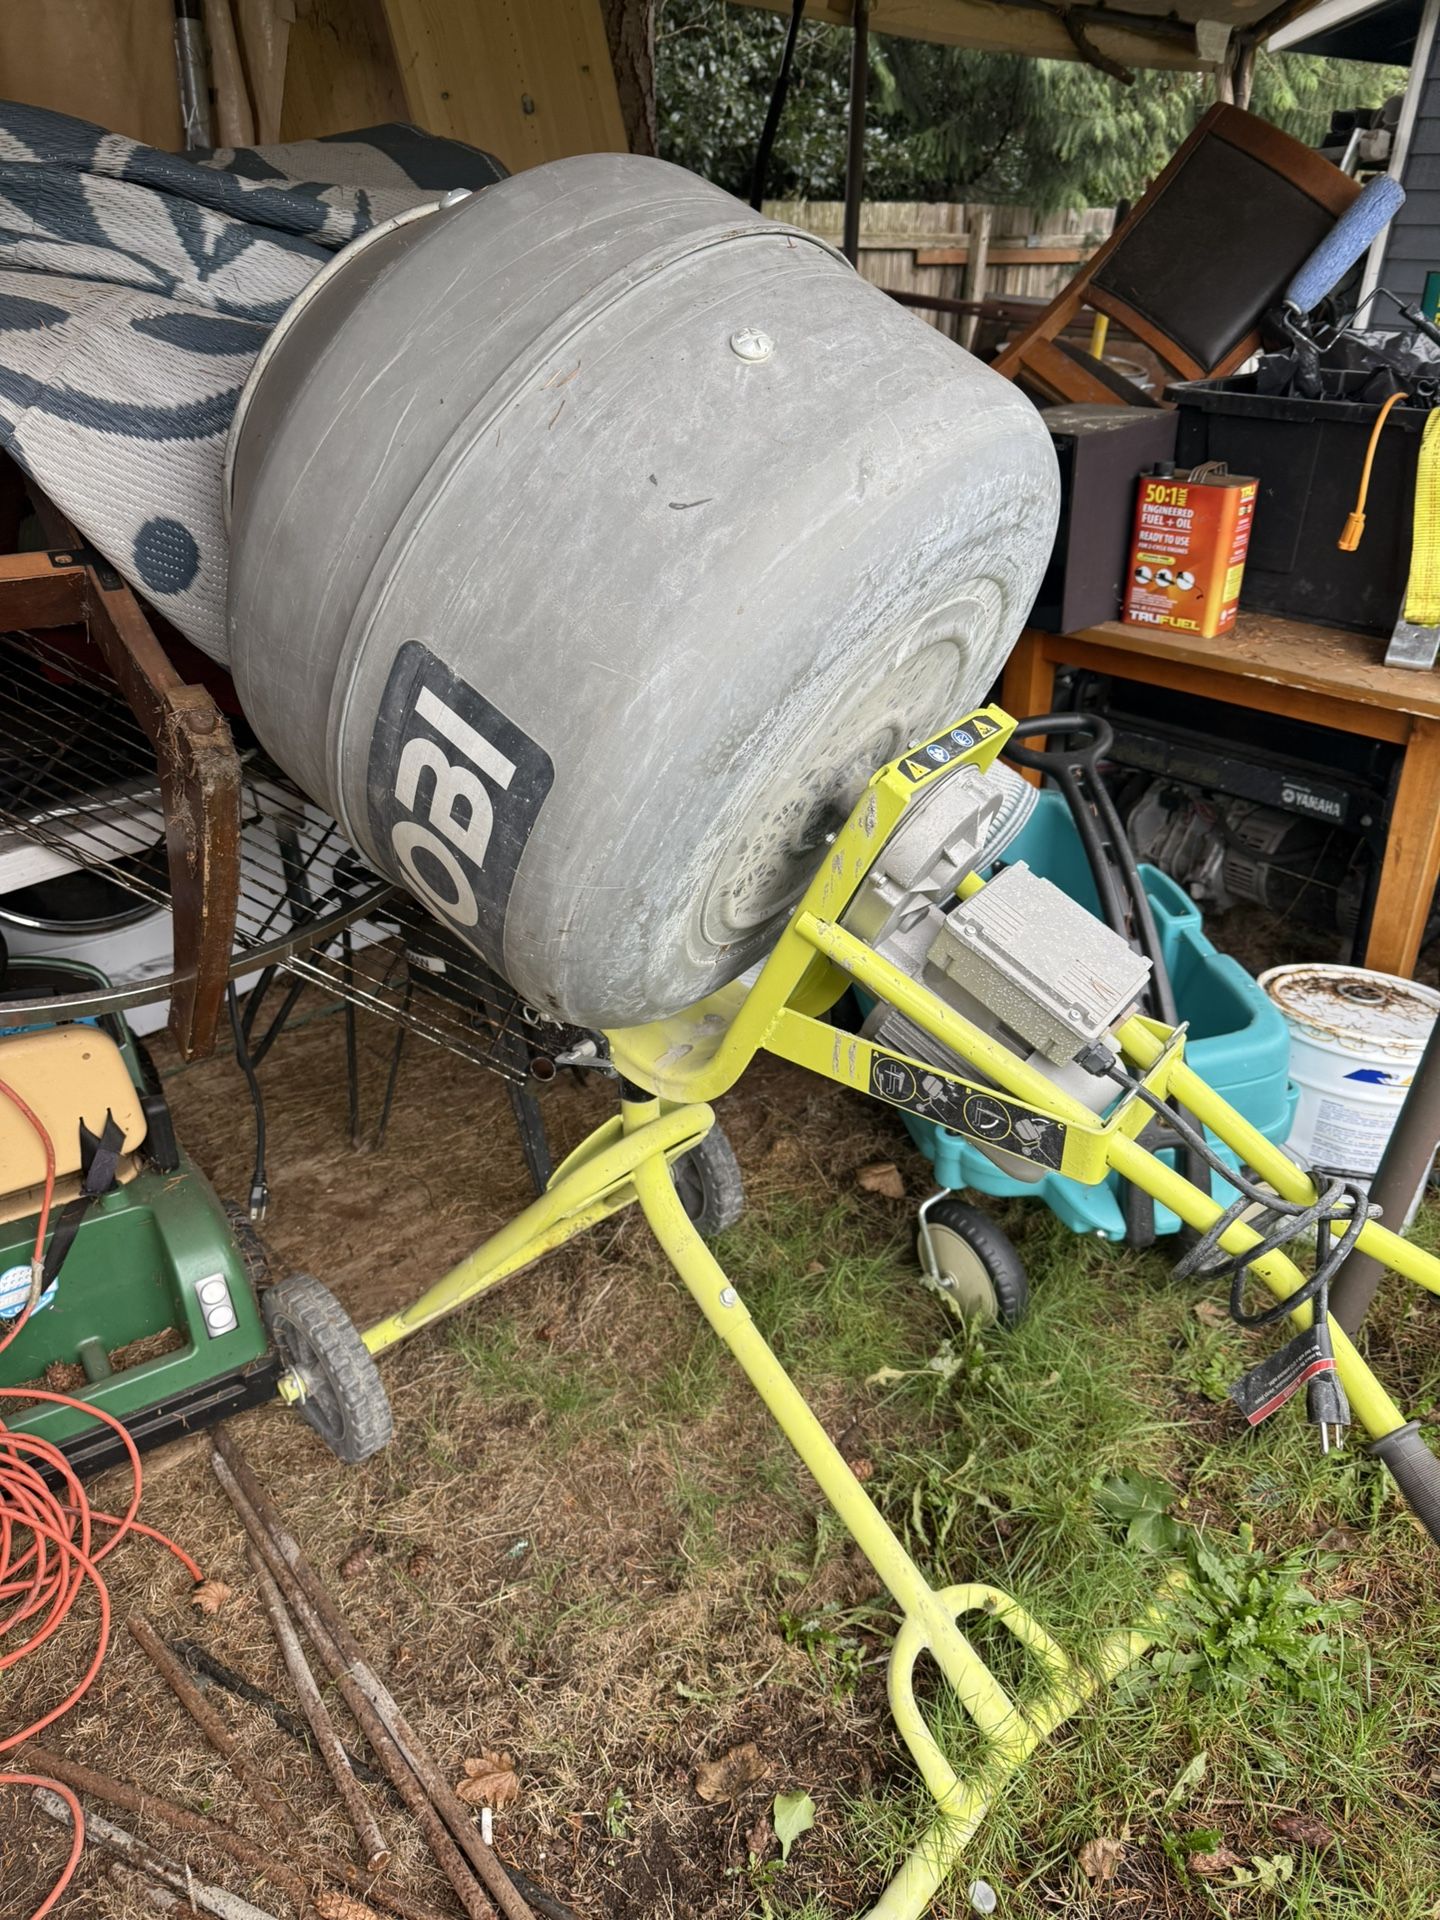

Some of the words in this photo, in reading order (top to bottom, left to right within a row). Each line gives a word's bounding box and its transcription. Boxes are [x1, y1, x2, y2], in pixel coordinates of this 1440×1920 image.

[1145, 484, 1178, 505] 50:1
[1177, 488, 1188, 506] MIX
[1143, 504, 1194, 518] ENGINEERED
[1142, 514, 1164, 525] FUEL
[1166, 518, 1175, 527] +
[1176, 518, 1192, 529] OIL
[1139, 531, 1163, 543] READY
[1164, 534, 1174, 544] TO
[1175, 536, 1190, 547] USE
[1130, 610, 1200, 630] TRUFUEL
[392, 686, 517, 930] OBI
[1296, 791, 1341, 817] YAMAHA
